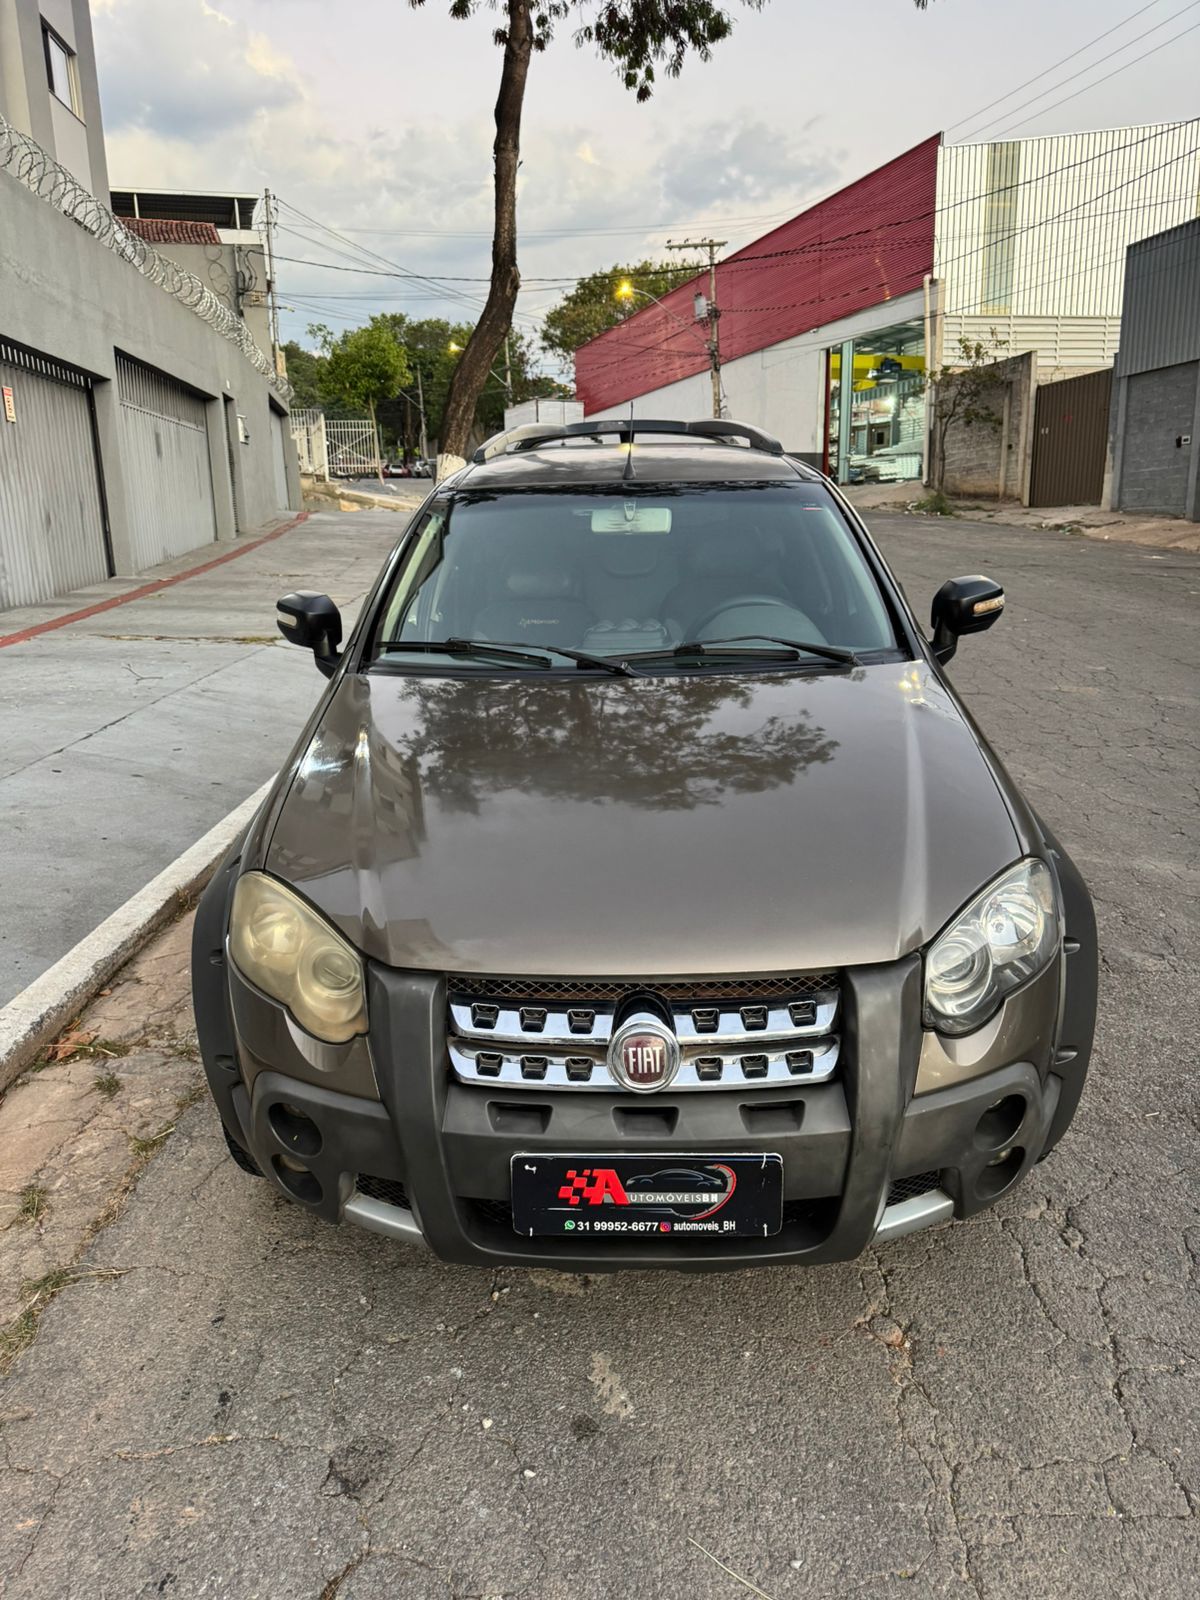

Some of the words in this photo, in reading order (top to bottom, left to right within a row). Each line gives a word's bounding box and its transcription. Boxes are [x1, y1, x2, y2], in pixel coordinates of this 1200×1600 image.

[629, 1047, 662, 1074] FIAT
[577, 1222, 590, 1231] 31
[594, 1221, 659, 1231] 99952-6677
[673, 1221, 736, 1233] automoveis_BH
